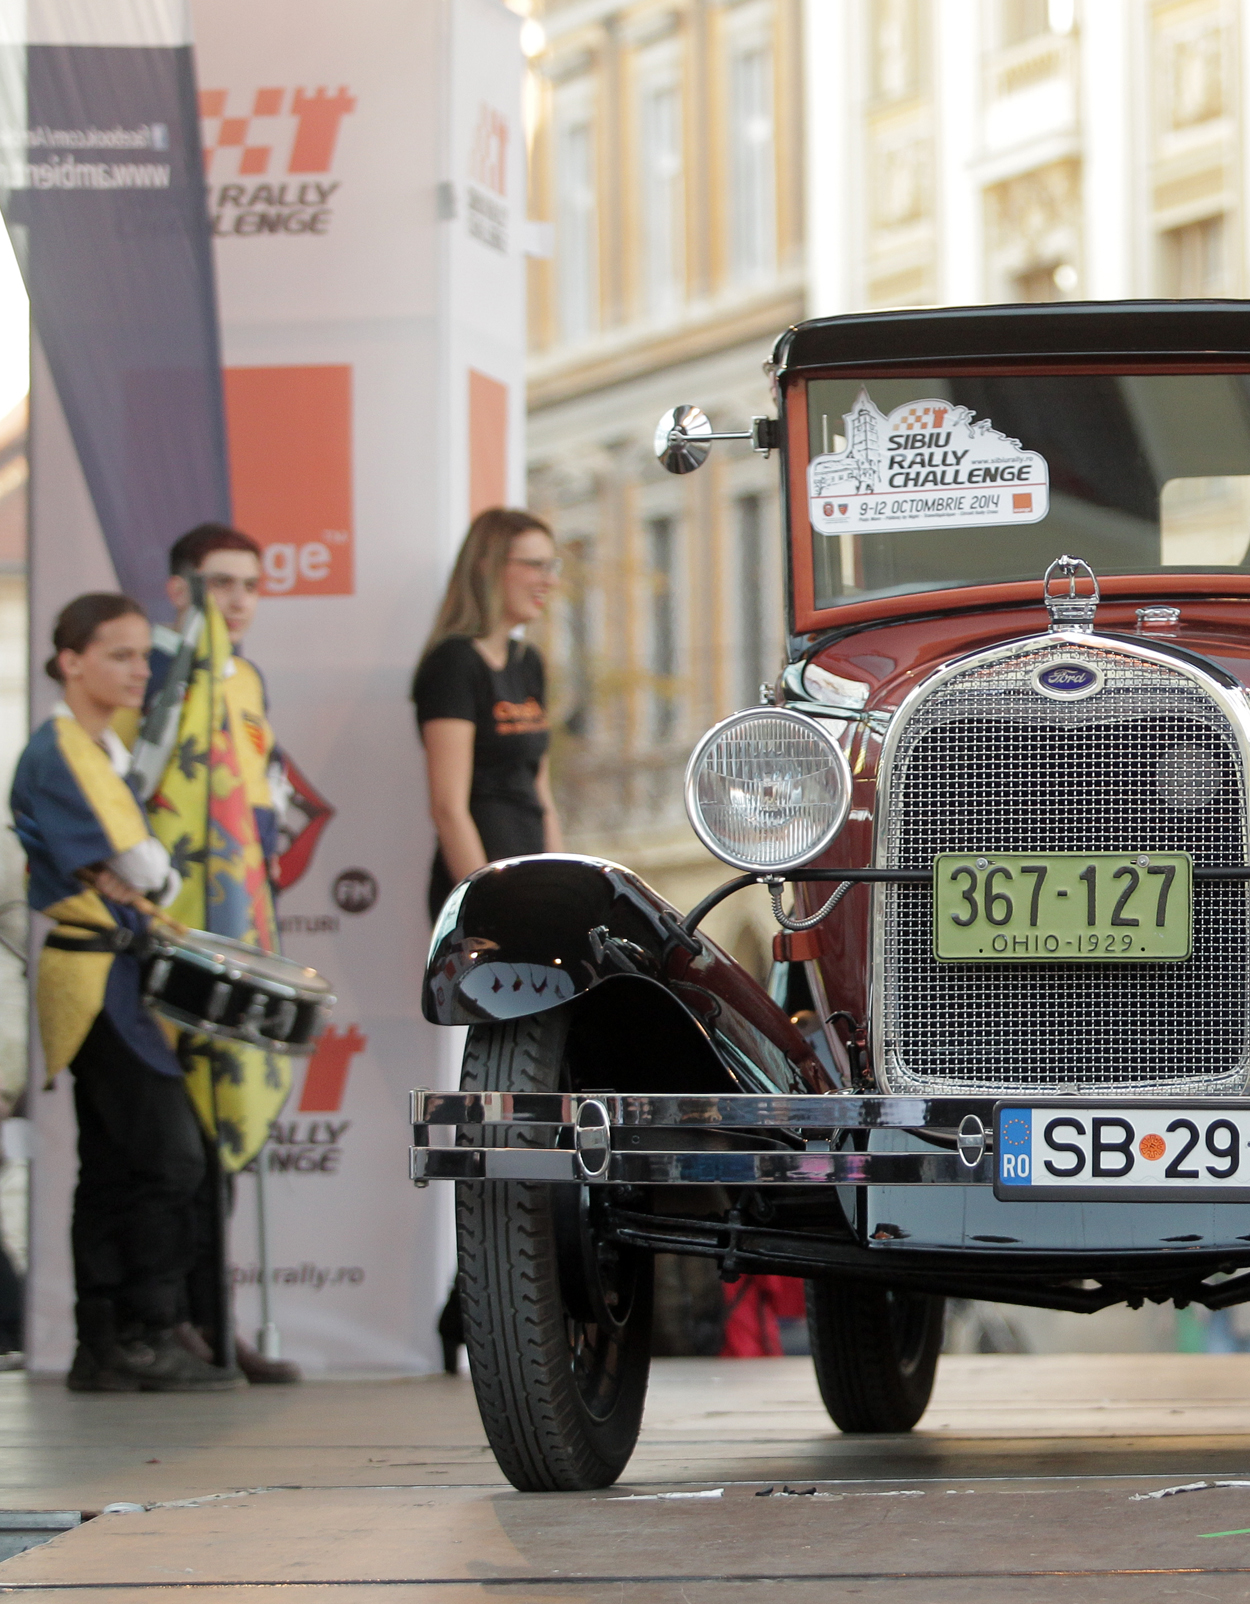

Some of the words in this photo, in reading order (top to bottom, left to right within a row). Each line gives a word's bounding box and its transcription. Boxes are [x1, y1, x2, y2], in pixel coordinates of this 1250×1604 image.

[217, 181, 342, 208] RALLY
[211, 208, 333, 236] LENGE
[887, 431, 952, 451] SIBIU
[888, 449, 969, 470] RALLY
[888, 465, 1032, 489] CHALLENGE
[860, 501, 887, 516] 9-12
[891, 496, 966, 514] OCTOMBRIE
[970, 494, 1001, 510] 2014
[1048, 669, 1087, 684] Ford
[950, 864, 1176, 927] 367-127
[992, 933, 1134, 953] OHIO-1929
[267, 1119, 351, 1146] ALLY
[1002, 1153, 1031, 1178] RO
[1043, 1116, 1135, 1178] SB
[1164, 1117, 1240, 1180] 29
